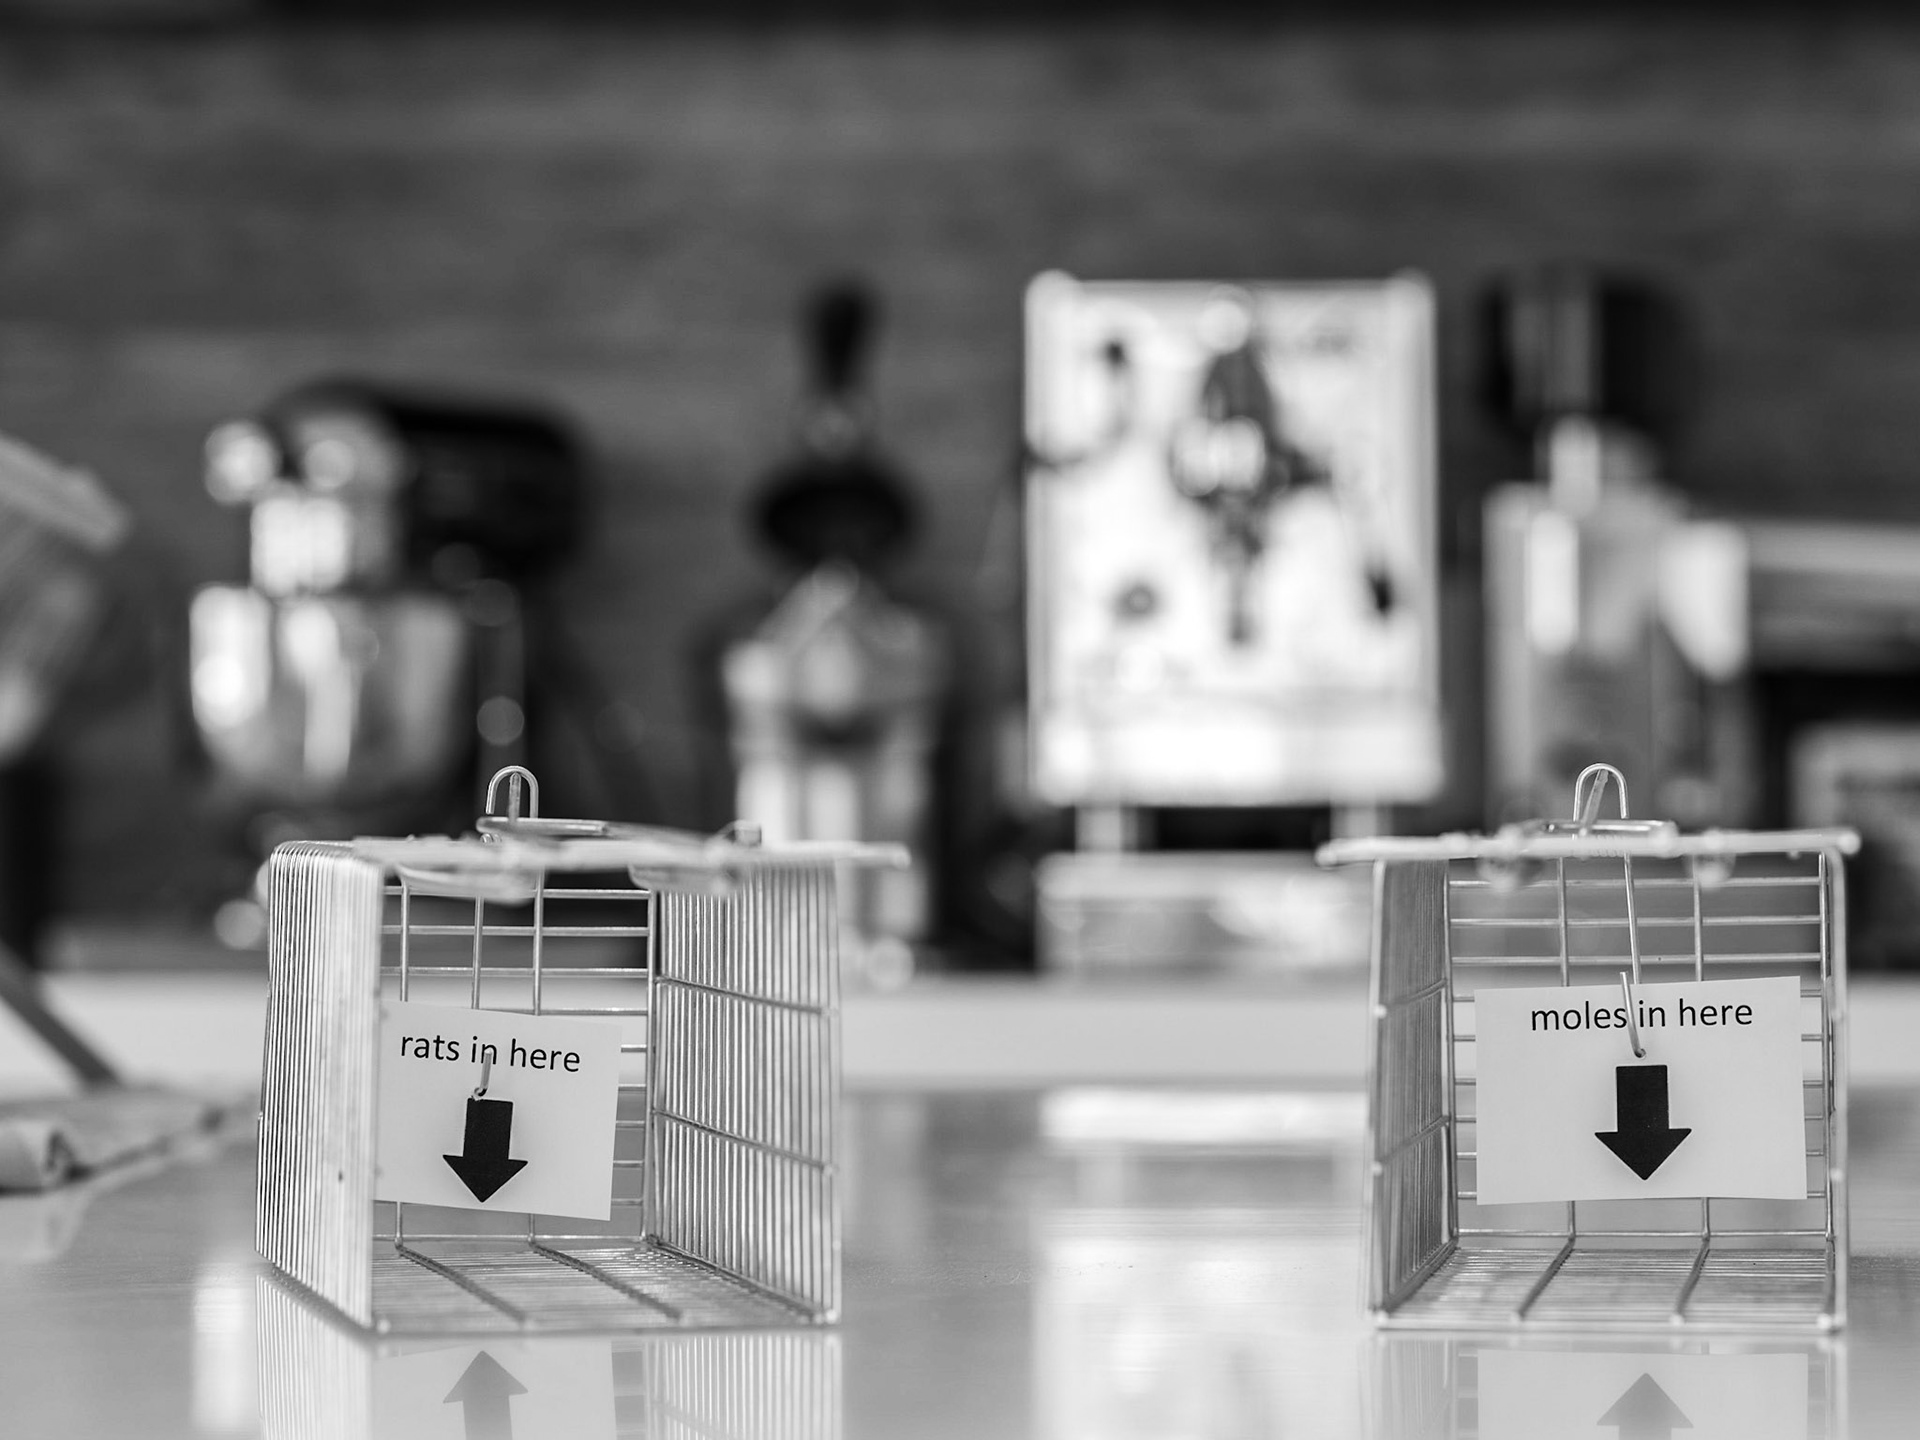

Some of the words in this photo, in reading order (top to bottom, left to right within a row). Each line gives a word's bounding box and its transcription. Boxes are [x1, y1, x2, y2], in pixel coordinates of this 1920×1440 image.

[1531, 1000, 1628, 1031] moles
[1638, 999, 1666, 1028] in
[1679, 997, 1753, 1027] here
[401, 1034, 460, 1062] rats
[471, 1035, 498, 1066] in
[510, 1038, 580, 1073] here
